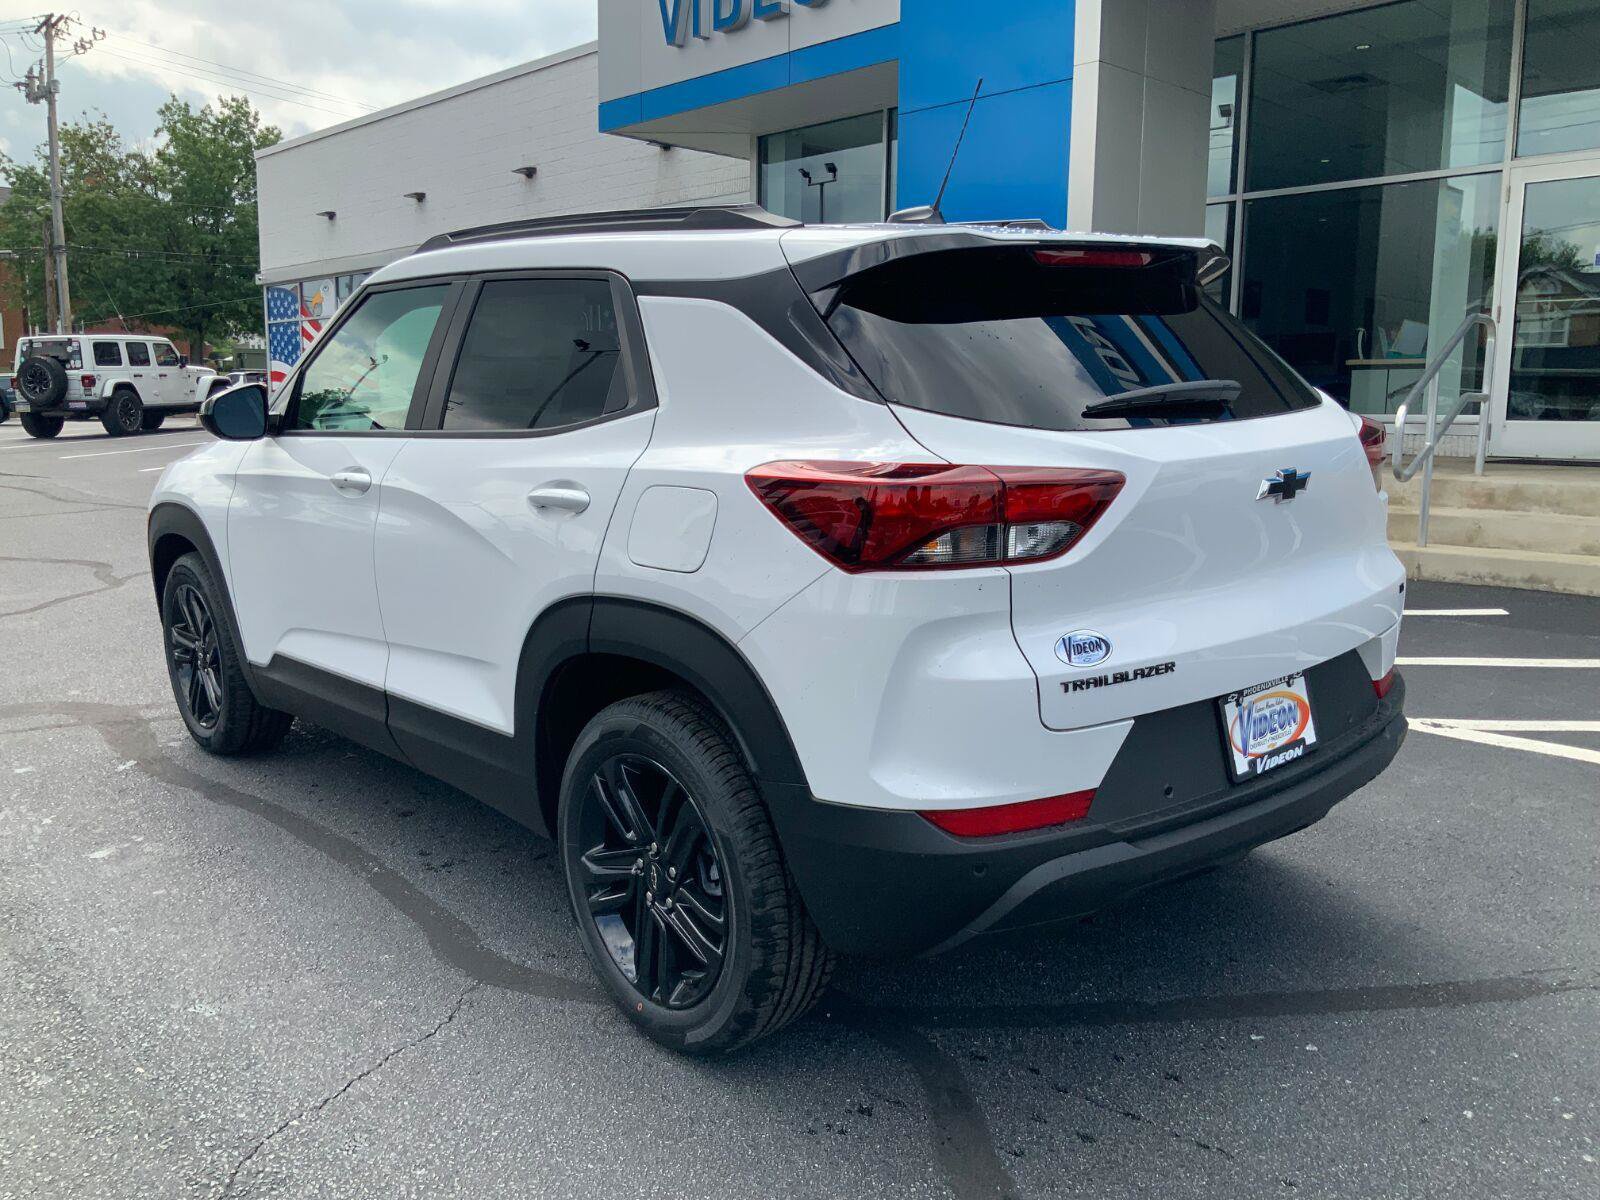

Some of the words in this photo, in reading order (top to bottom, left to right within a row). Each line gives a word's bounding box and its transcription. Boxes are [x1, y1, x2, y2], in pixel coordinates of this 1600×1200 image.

[659, 0, 831, 48] VID
[1061, 636, 1103, 663] VIDEON
[1060, 661, 1176, 693] TRAILBLAZER
[1243, 677, 1289, 697] PHOENIXVILLE
[1238, 700, 1298, 758] VIDEON
[1256, 746, 1303, 775] VIDEON
